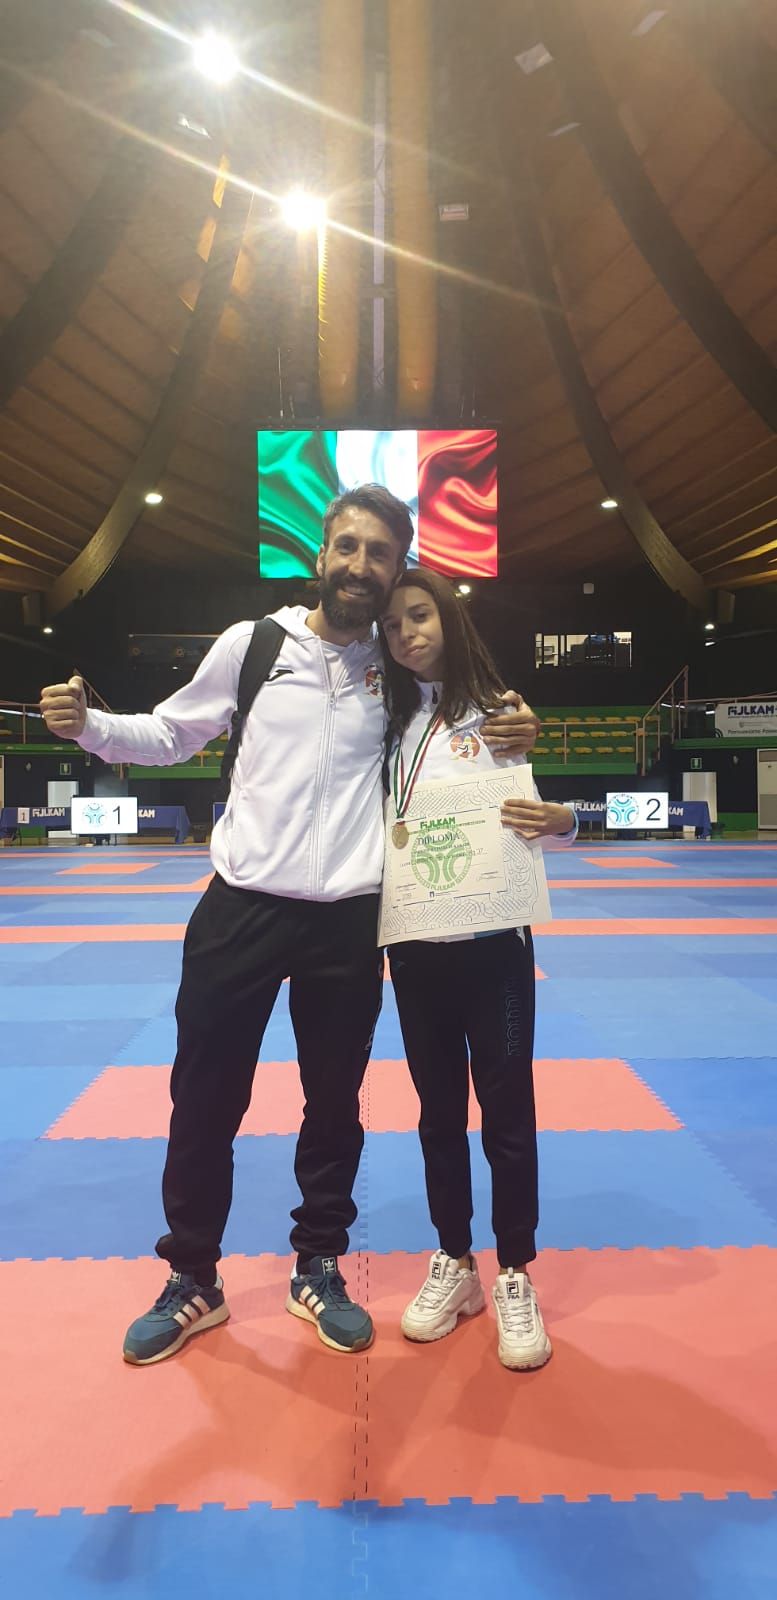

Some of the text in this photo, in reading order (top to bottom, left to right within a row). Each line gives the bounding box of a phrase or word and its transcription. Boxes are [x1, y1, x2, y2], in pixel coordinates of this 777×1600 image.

[112, 805, 121, 825] 1
[646, 798, 661, 821] 2
[416, 830, 461, 846] DIPLOMA
